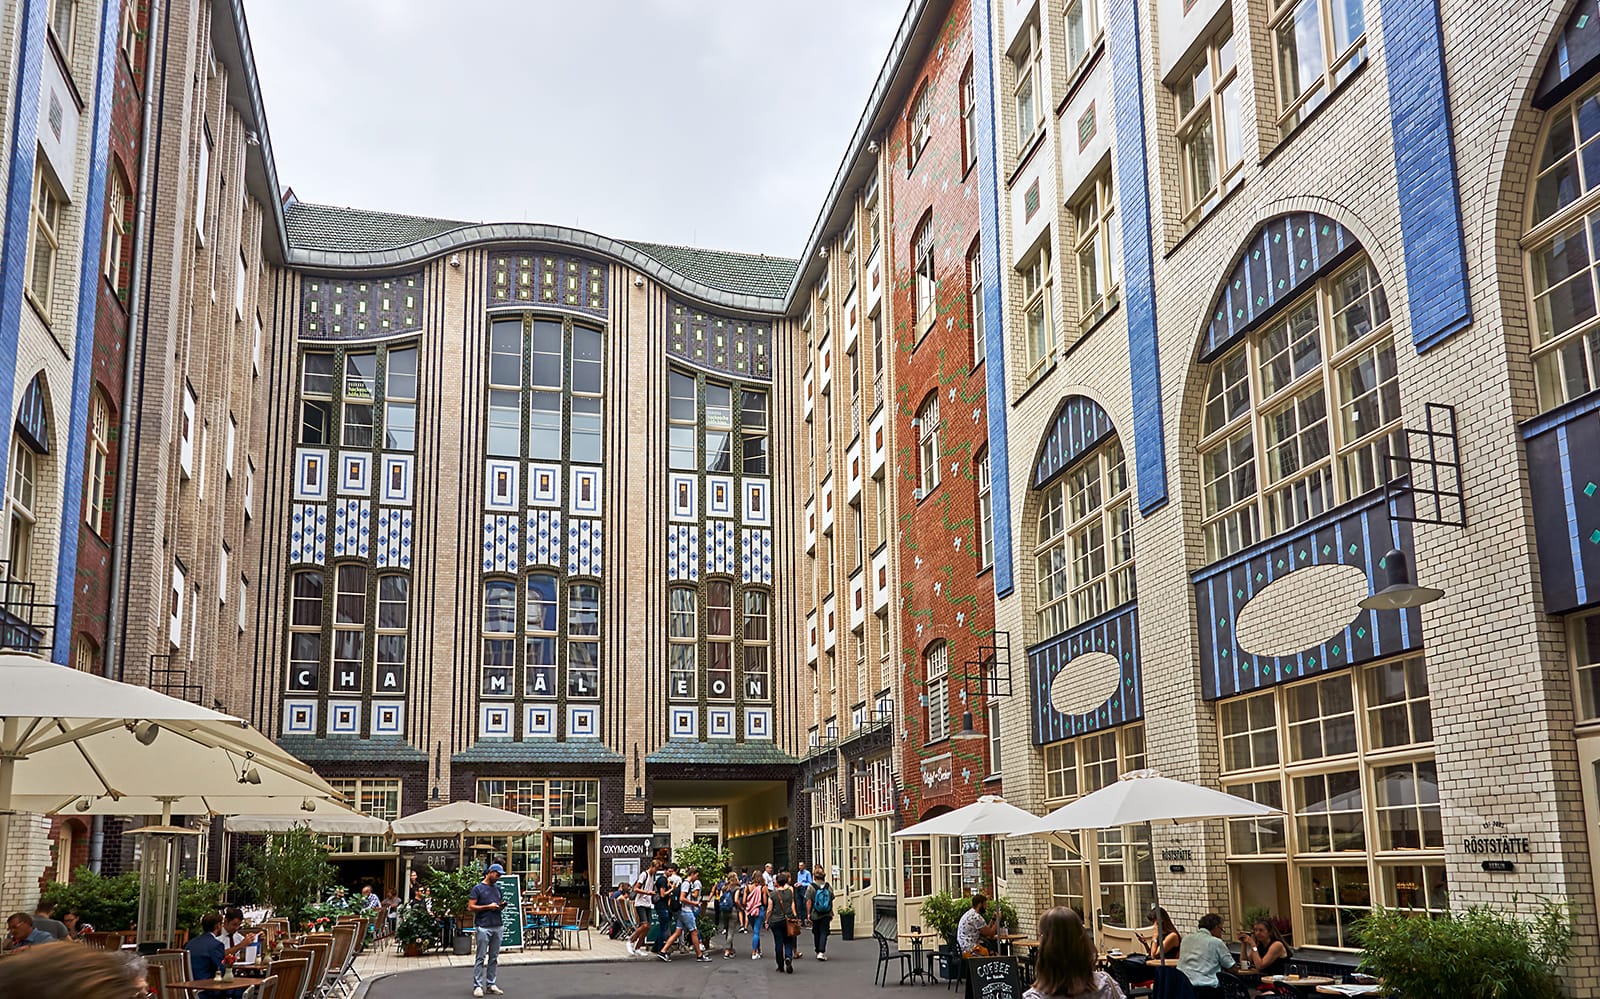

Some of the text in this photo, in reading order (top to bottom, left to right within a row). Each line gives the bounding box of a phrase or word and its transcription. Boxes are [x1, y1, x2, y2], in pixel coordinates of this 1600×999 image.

[603, 844, 643, 854] OXYMORON
[1463, 835, 1529, 854] RÖSTSTÄTTE
[427, 855, 446, 866] BAR
[976, 961, 1011, 978] COFFEE
